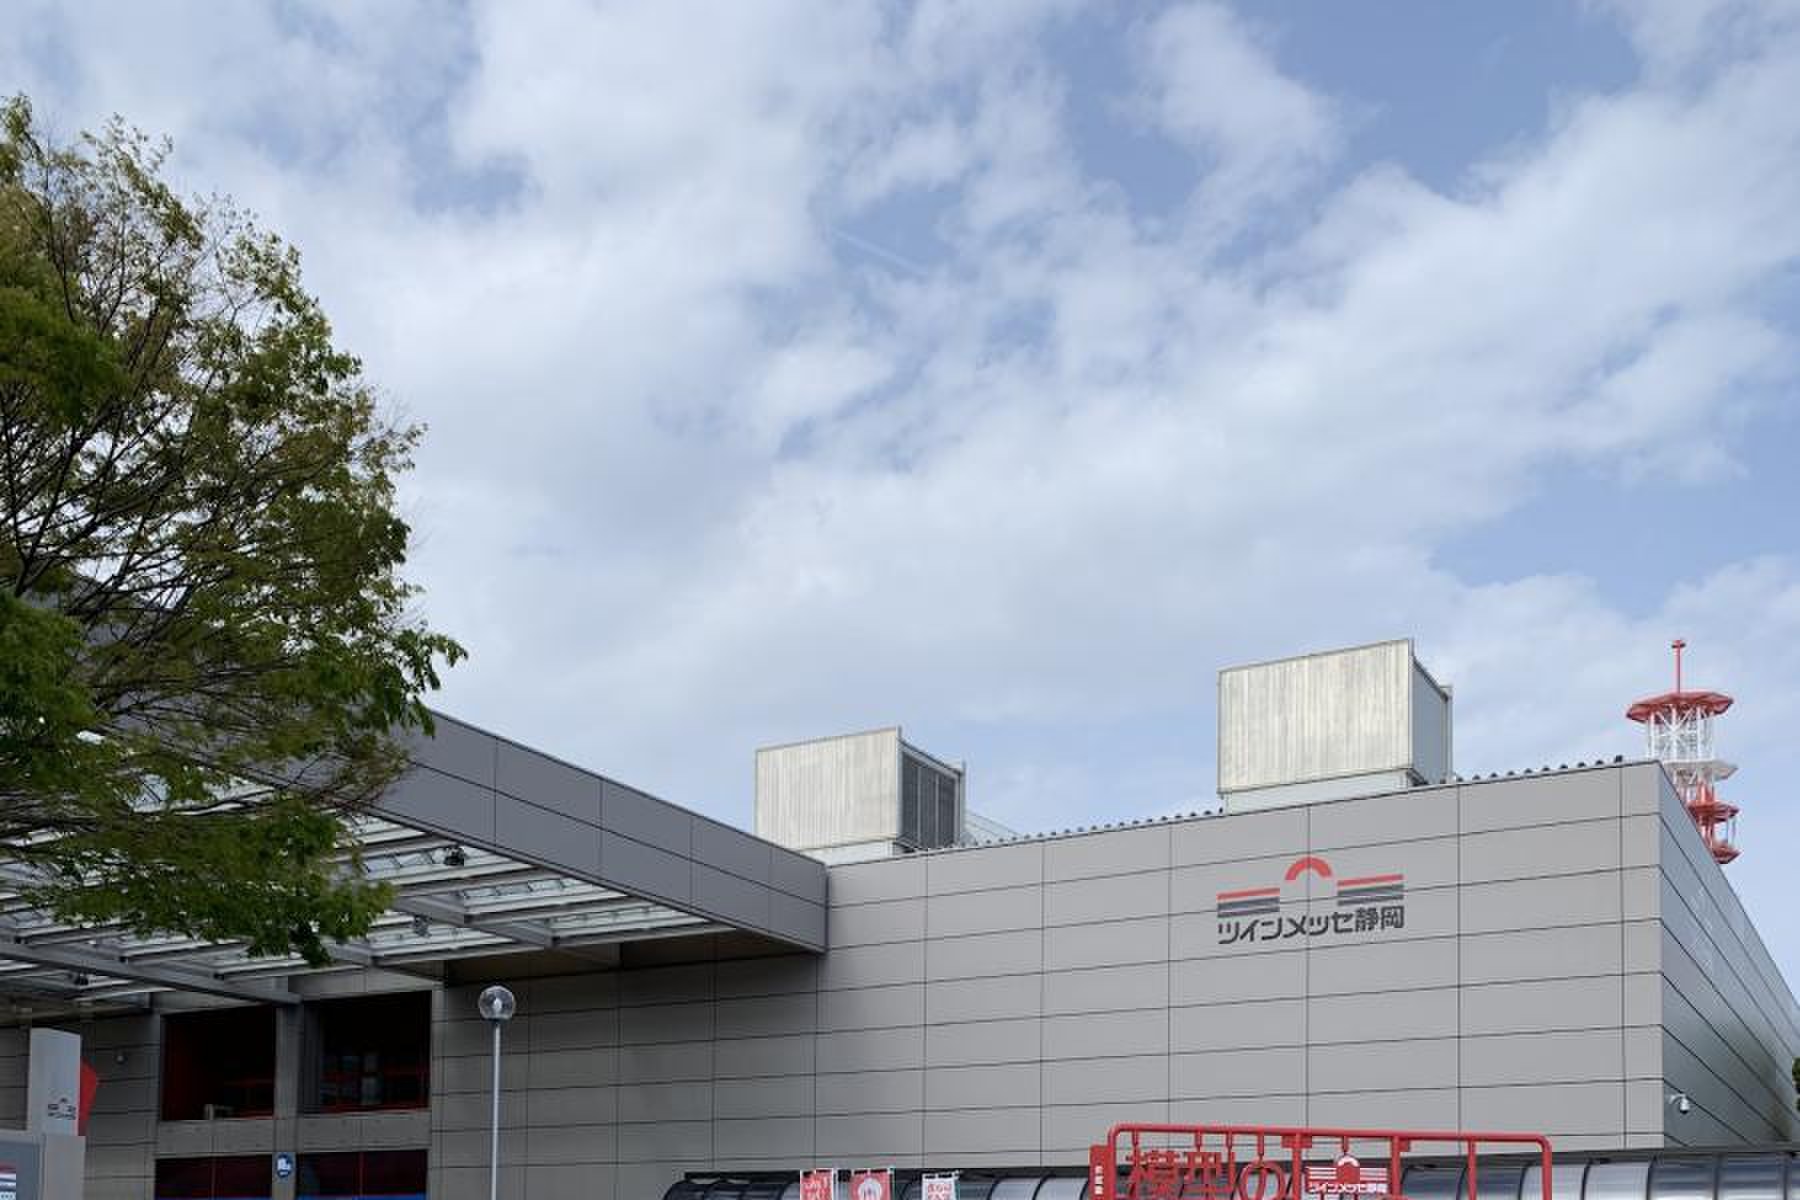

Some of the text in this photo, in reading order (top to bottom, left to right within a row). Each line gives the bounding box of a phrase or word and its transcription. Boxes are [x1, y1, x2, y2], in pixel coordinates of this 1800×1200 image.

[1218, 906, 1404, 944] ツインメッセ静岡
